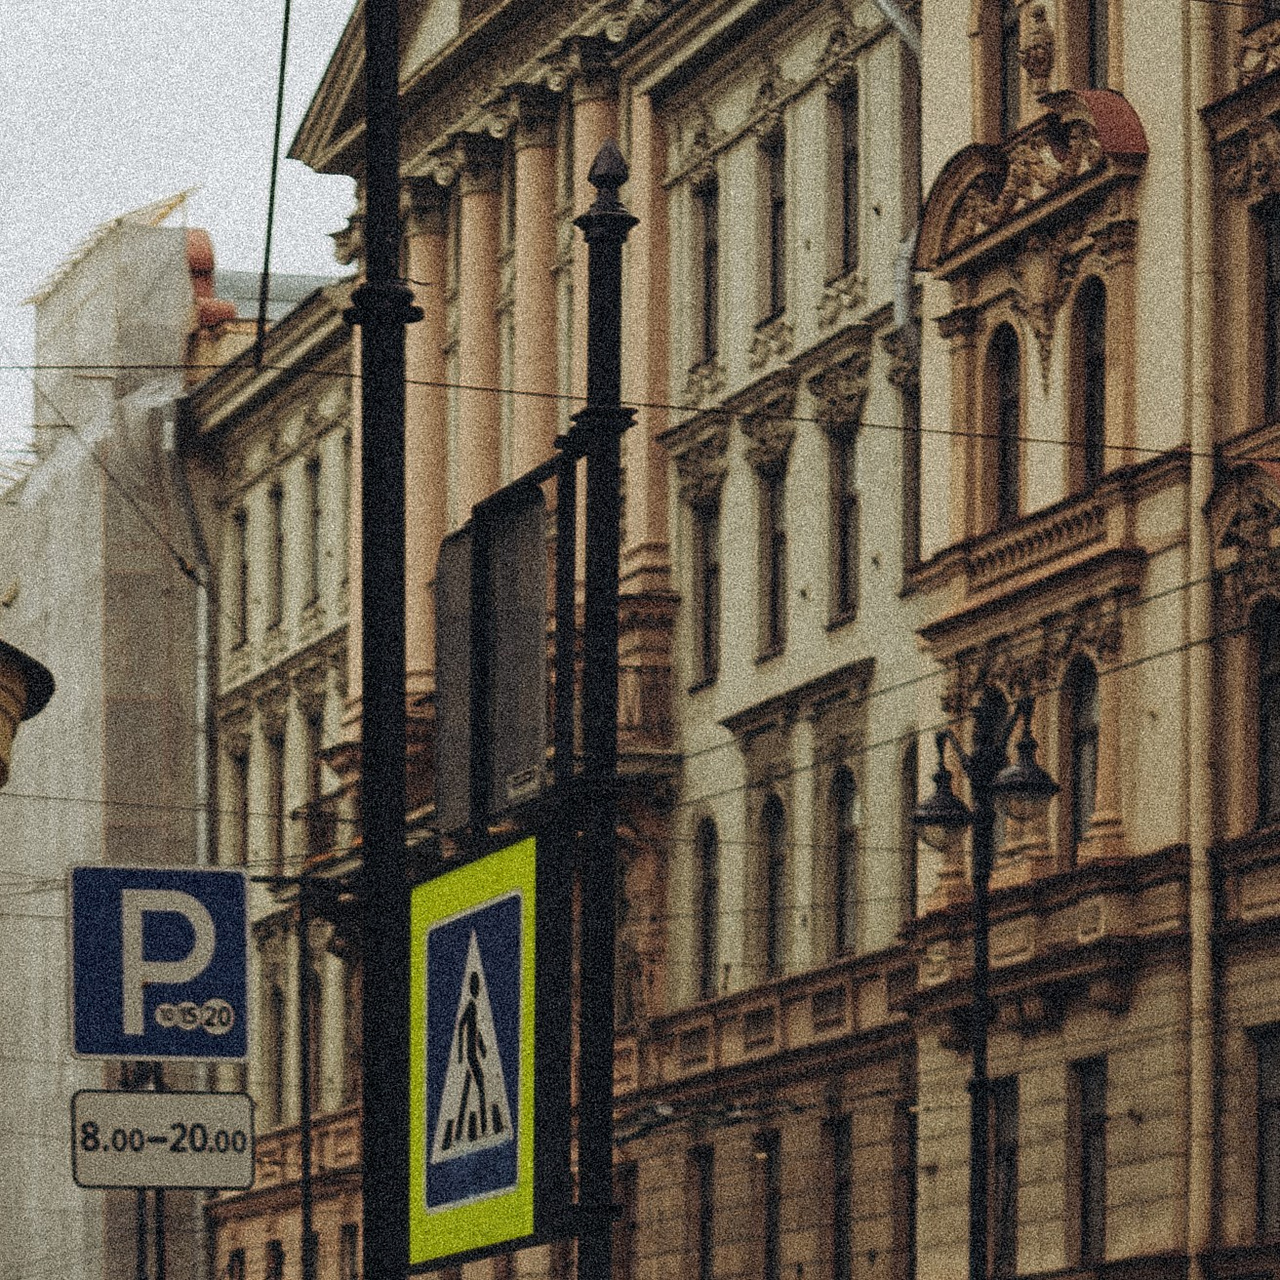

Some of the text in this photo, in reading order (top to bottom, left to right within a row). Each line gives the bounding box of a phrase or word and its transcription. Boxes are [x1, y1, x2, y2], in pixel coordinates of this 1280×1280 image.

[122, 888, 216, 1036] P
[179, 1005, 198, 1024] 15
[204, 1005, 231, 1027] 20
